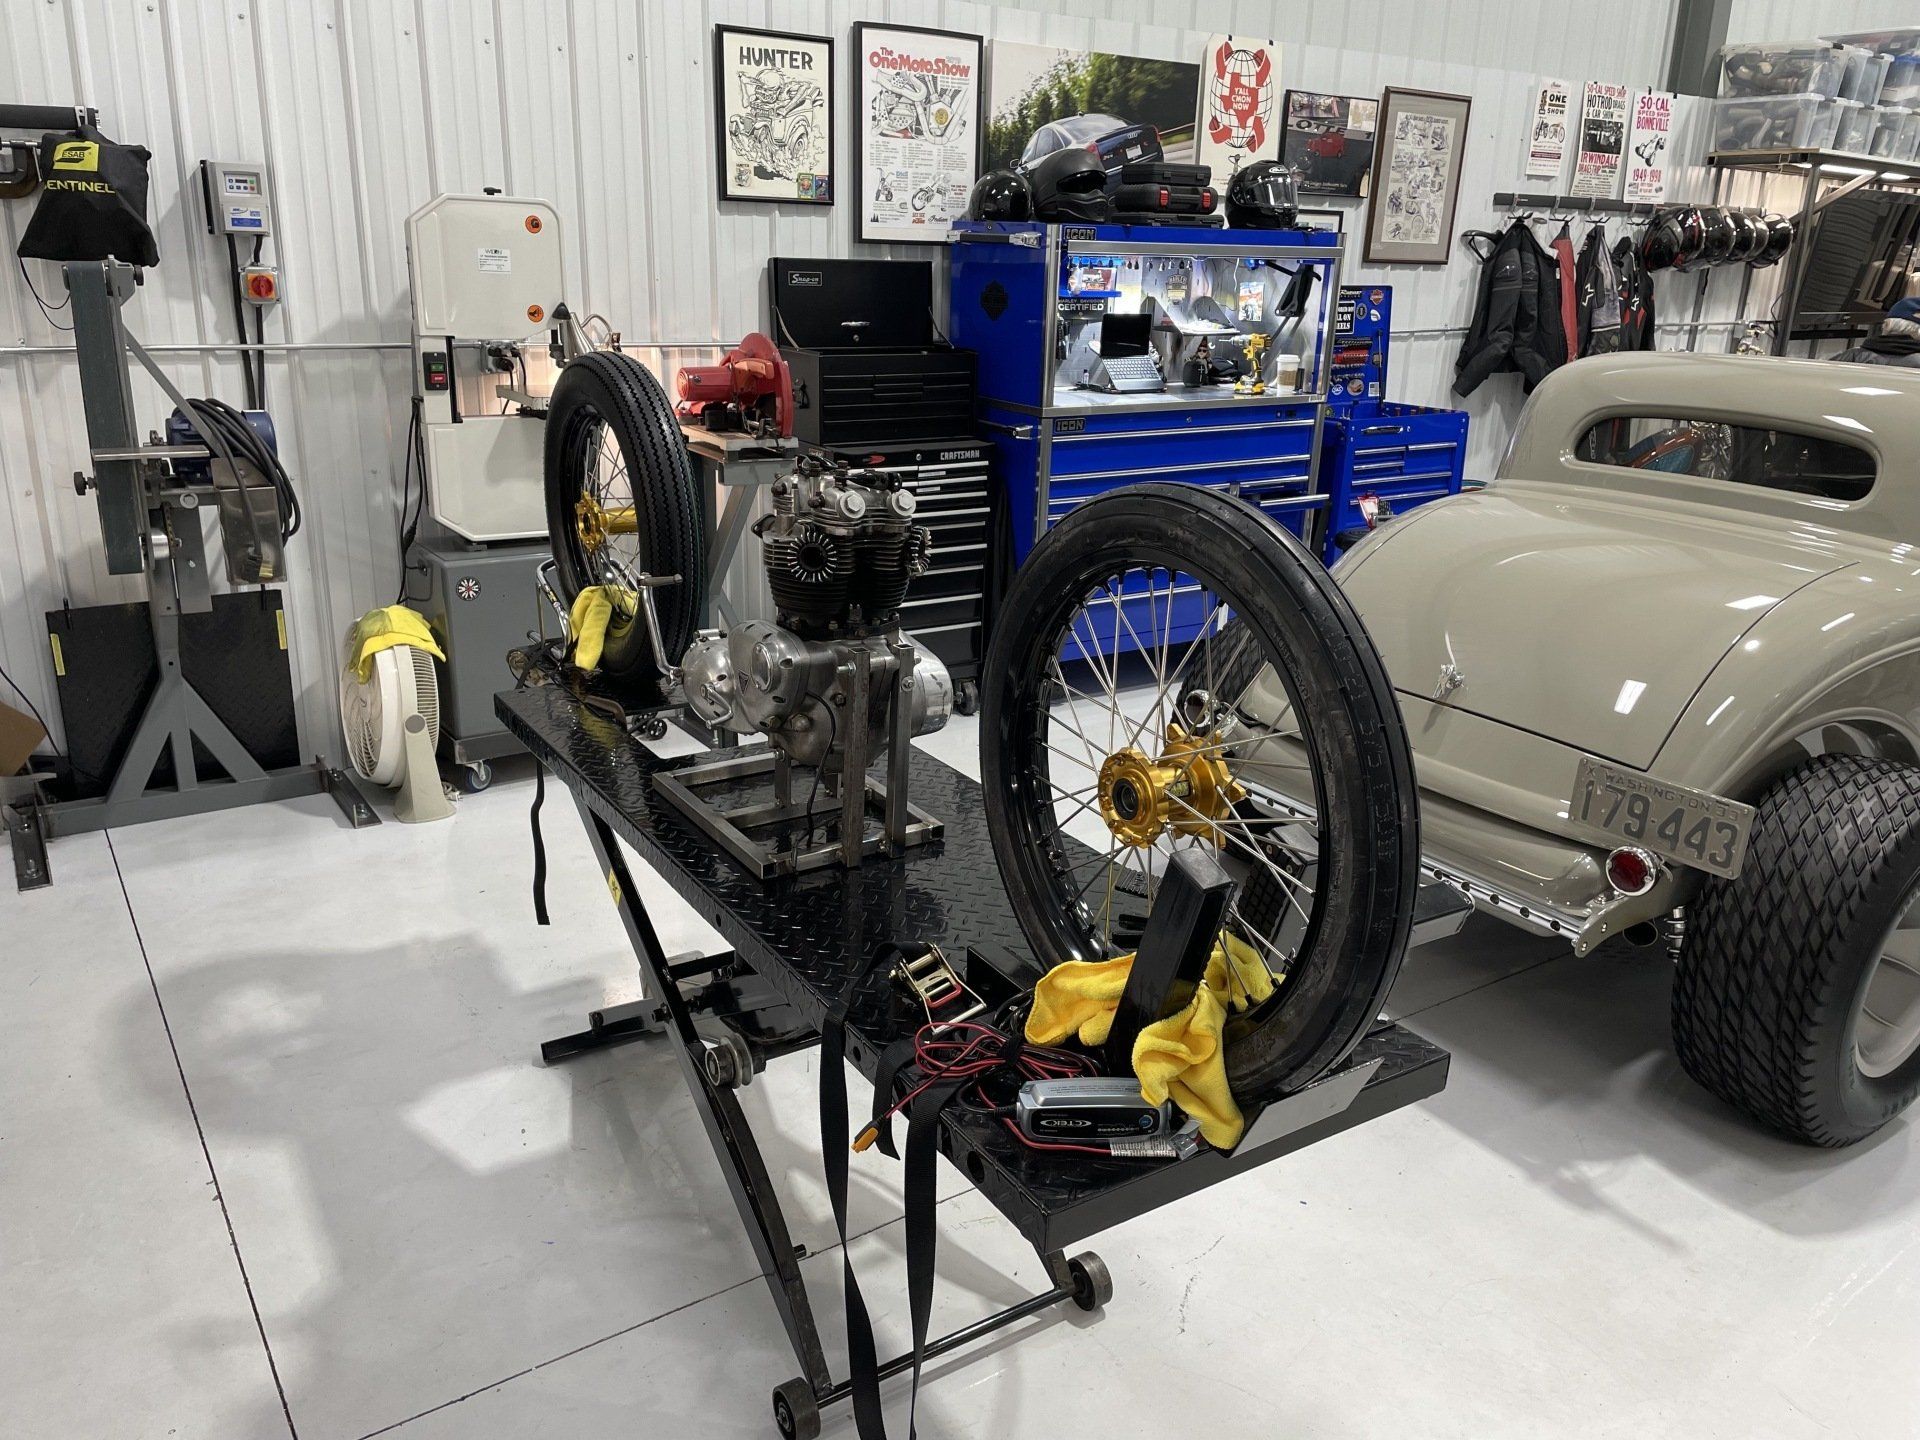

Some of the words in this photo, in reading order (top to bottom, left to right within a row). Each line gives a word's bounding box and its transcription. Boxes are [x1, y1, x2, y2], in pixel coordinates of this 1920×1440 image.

[880, 47, 894, 56] The
[740, 46, 813, 70] HUNTER
[1549, 93, 1567, 104] ONE
[1640, 96, 1670, 112] SO-CAL
[1232, 102, 1250, 111] NOW
[1547, 107, 1565, 115] SHOW
[1592, 109, 1601, 119] CAR
[1637, 109, 1656, 117] SPEED
[1636, 116, 1670, 132] BONNEVILLE
[1580, 152, 1620, 166] IRWINDALE
[45, 179, 116, 194] ENTINEL
[1066, 228, 1095, 240] ICON
[1057, 303, 1104, 311] CERTIFIED
[1056, 419, 1084, 431] ICON
[940, 449, 980, 461] CRAFTSMAN
[1604, 771, 1712, 813] WASHINGTON
